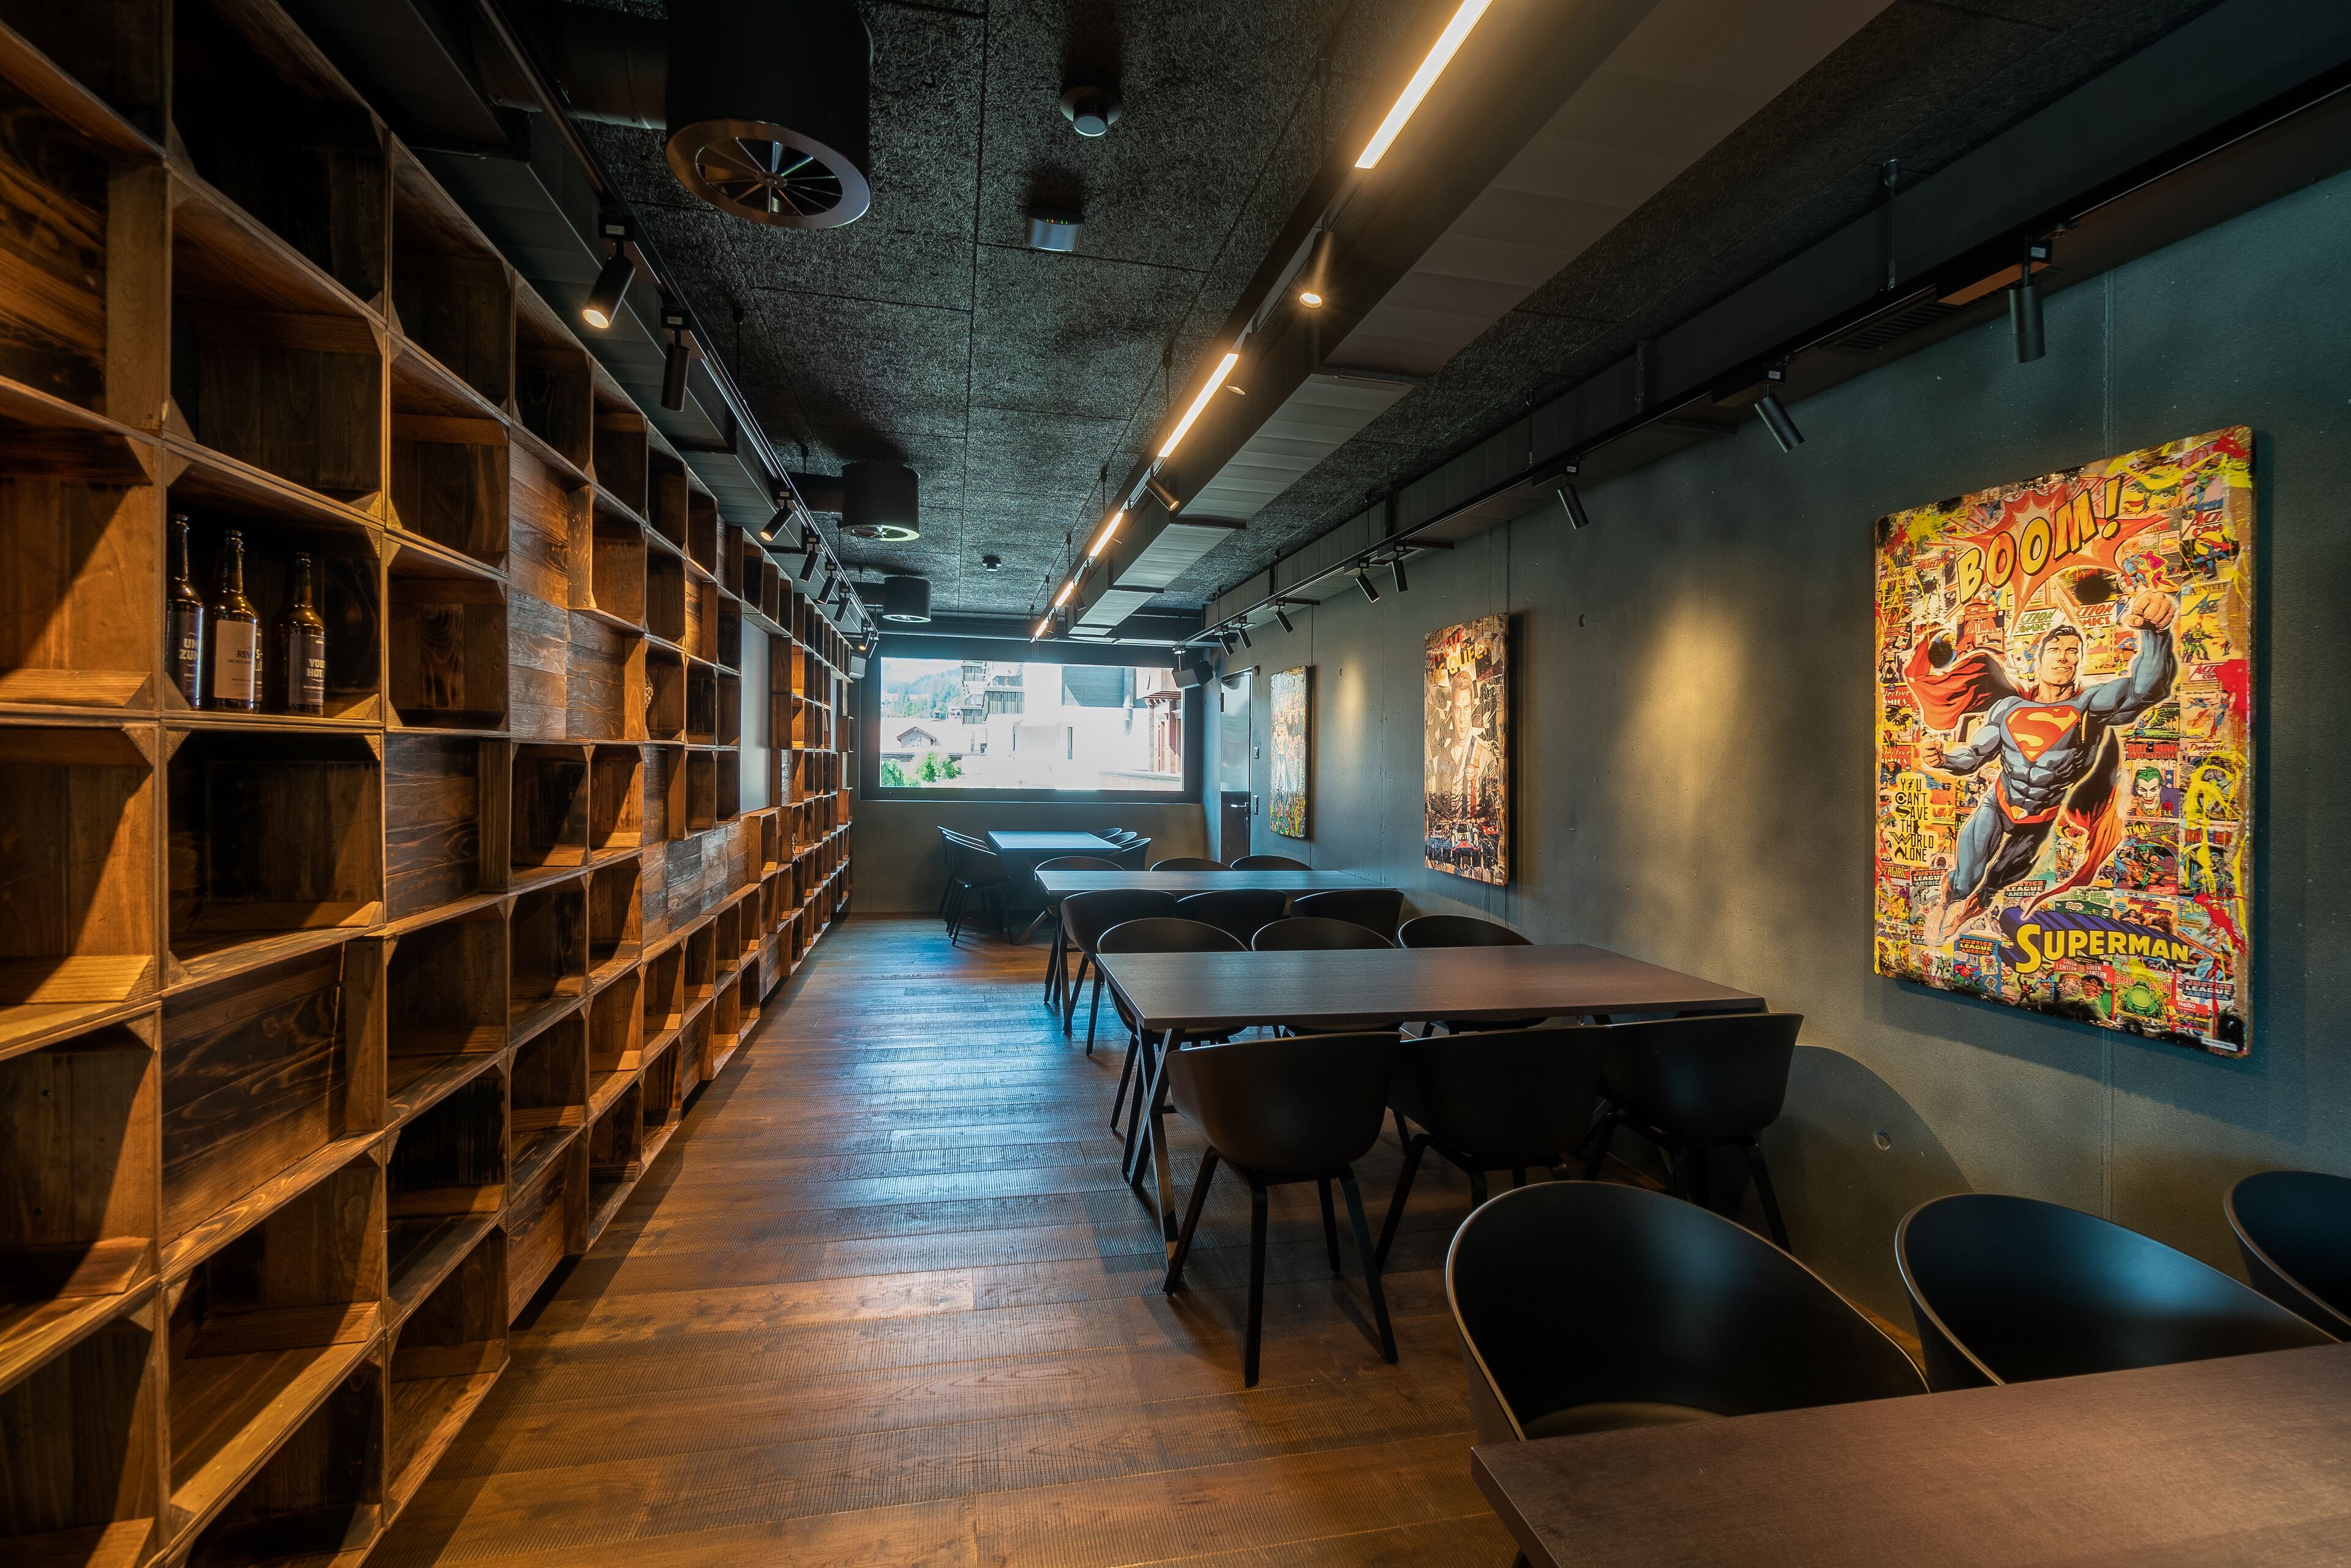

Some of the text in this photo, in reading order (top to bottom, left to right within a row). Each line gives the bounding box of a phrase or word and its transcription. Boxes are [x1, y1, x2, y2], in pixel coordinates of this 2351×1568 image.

[1957, 475, 2125, 604] BOOM!
[2020, 609, 2054, 623] CTION
[2076, 603, 2115, 617] CTION
[2019, 622, 2051, 633] OMICS
[2083, 617, 2110, 627] MICS
[1881, 748, 1911, 756] etective
[1900, 778, 1922, 792] YOU
[1895, 792, 1927, 806] CAN'T
[1895, 805, 1929, 820] SAVE
[2124, 823, 2151, 836] ATMAN
[1888, 831, 1934, 849] WORLD
[1894, 844, 1927, 863] ALONE
[2015, 923, 2189, 973] SUPERMAN
[2056, 962, 2077, 972] LANTERN
[2063, 958, 2077, 967] GREEN
[2115, 974, 2135, 985] GREEN
[2186, 991, 2229, 1000] AMERCA
[2177, 1000, 2196, 1009] Hello
